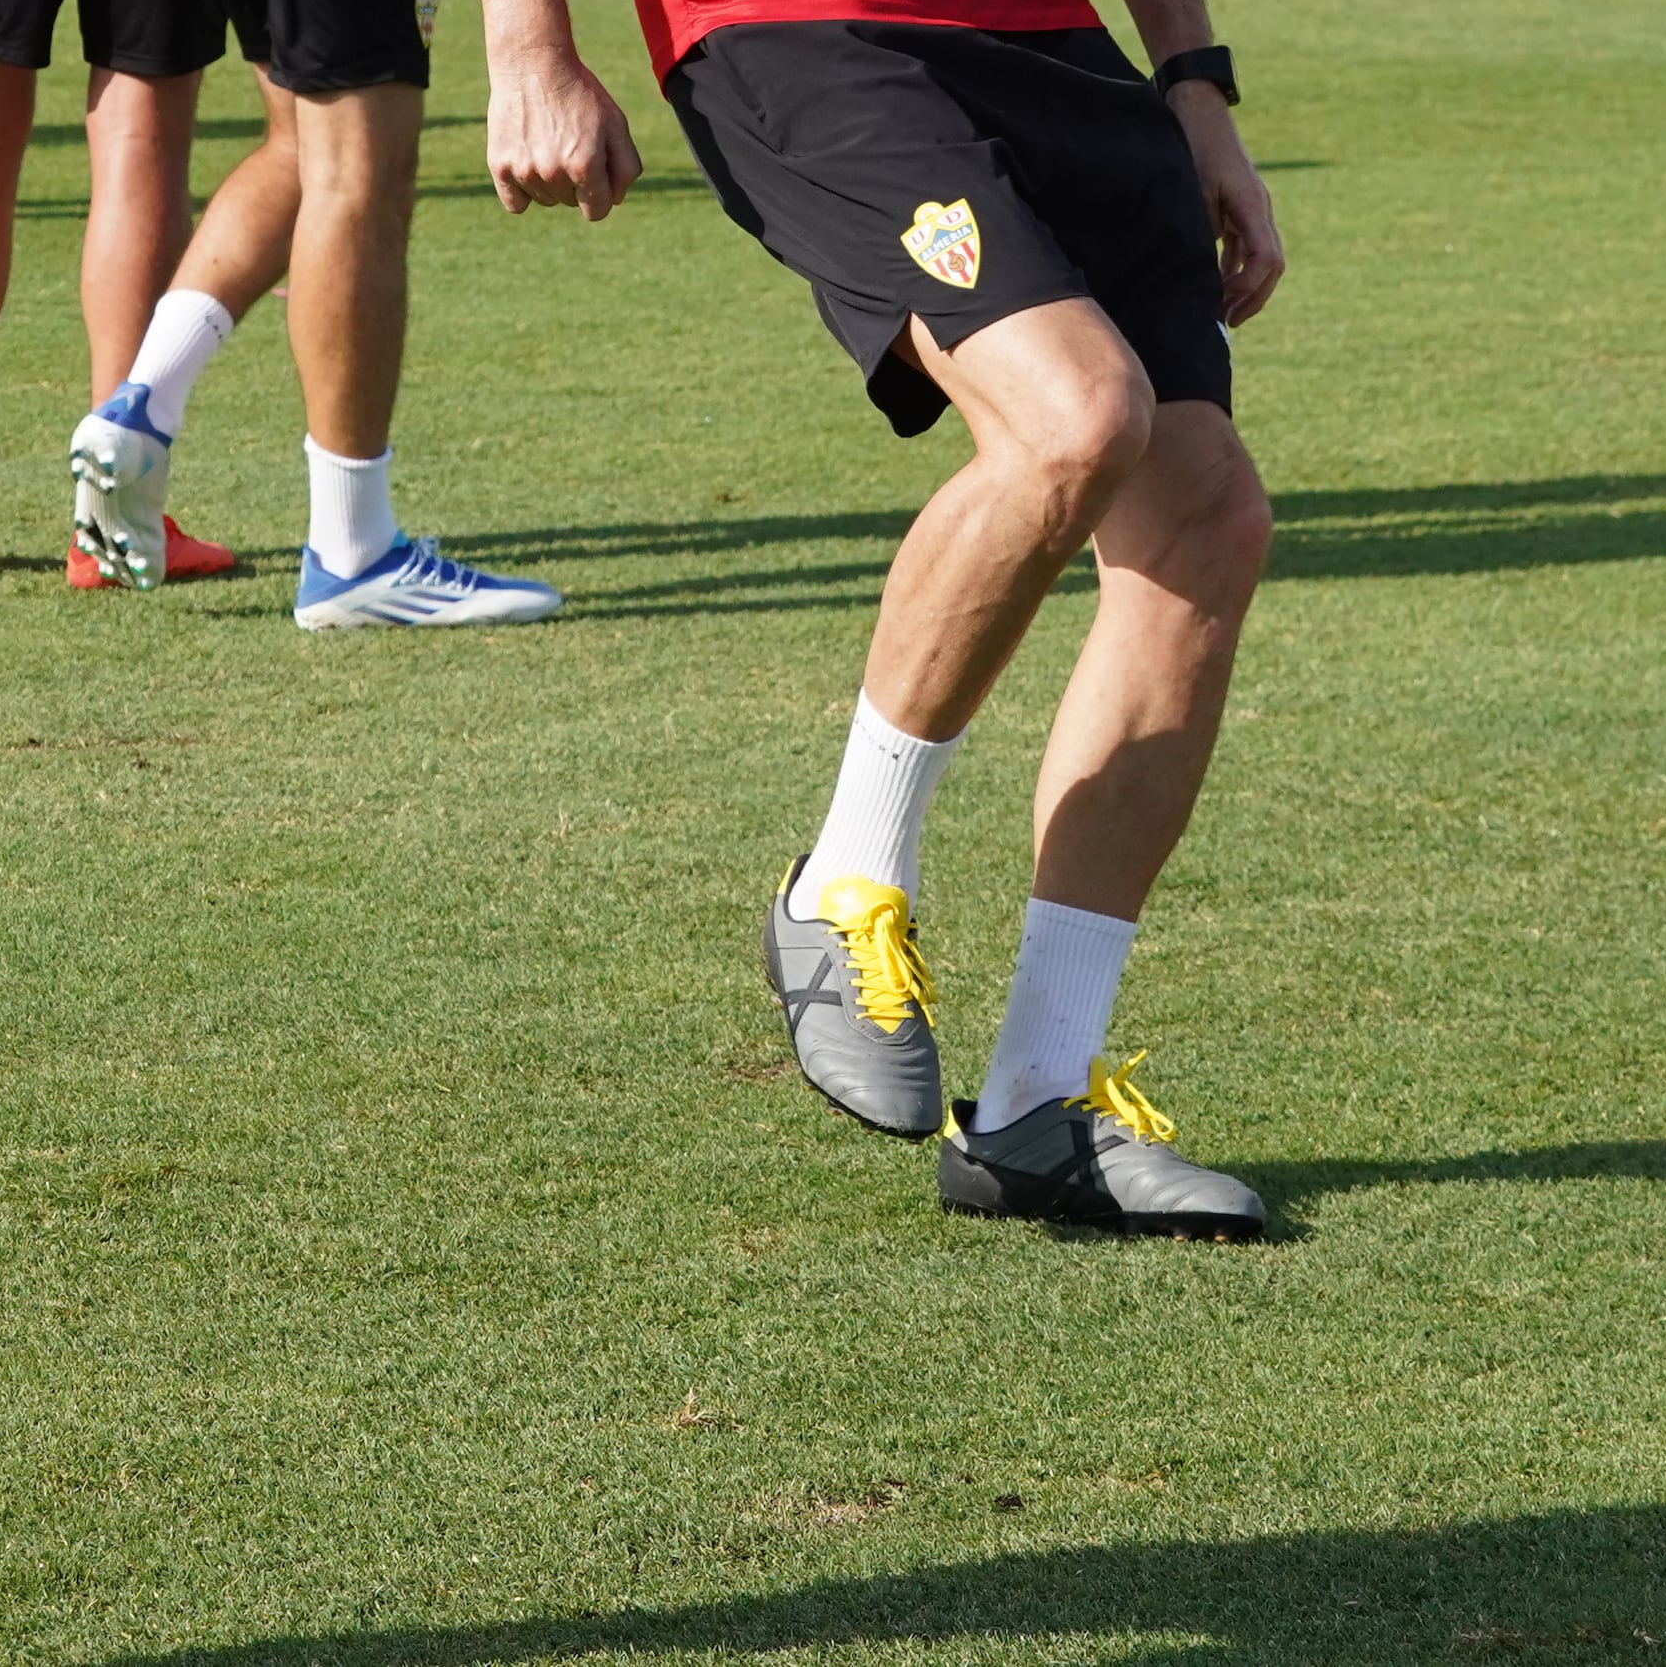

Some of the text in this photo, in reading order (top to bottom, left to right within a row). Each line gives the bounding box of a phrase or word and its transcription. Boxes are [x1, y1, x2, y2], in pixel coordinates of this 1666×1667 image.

[911, 211, 961, 245] U D
[921, 226, 972, 262] ALMERIA
